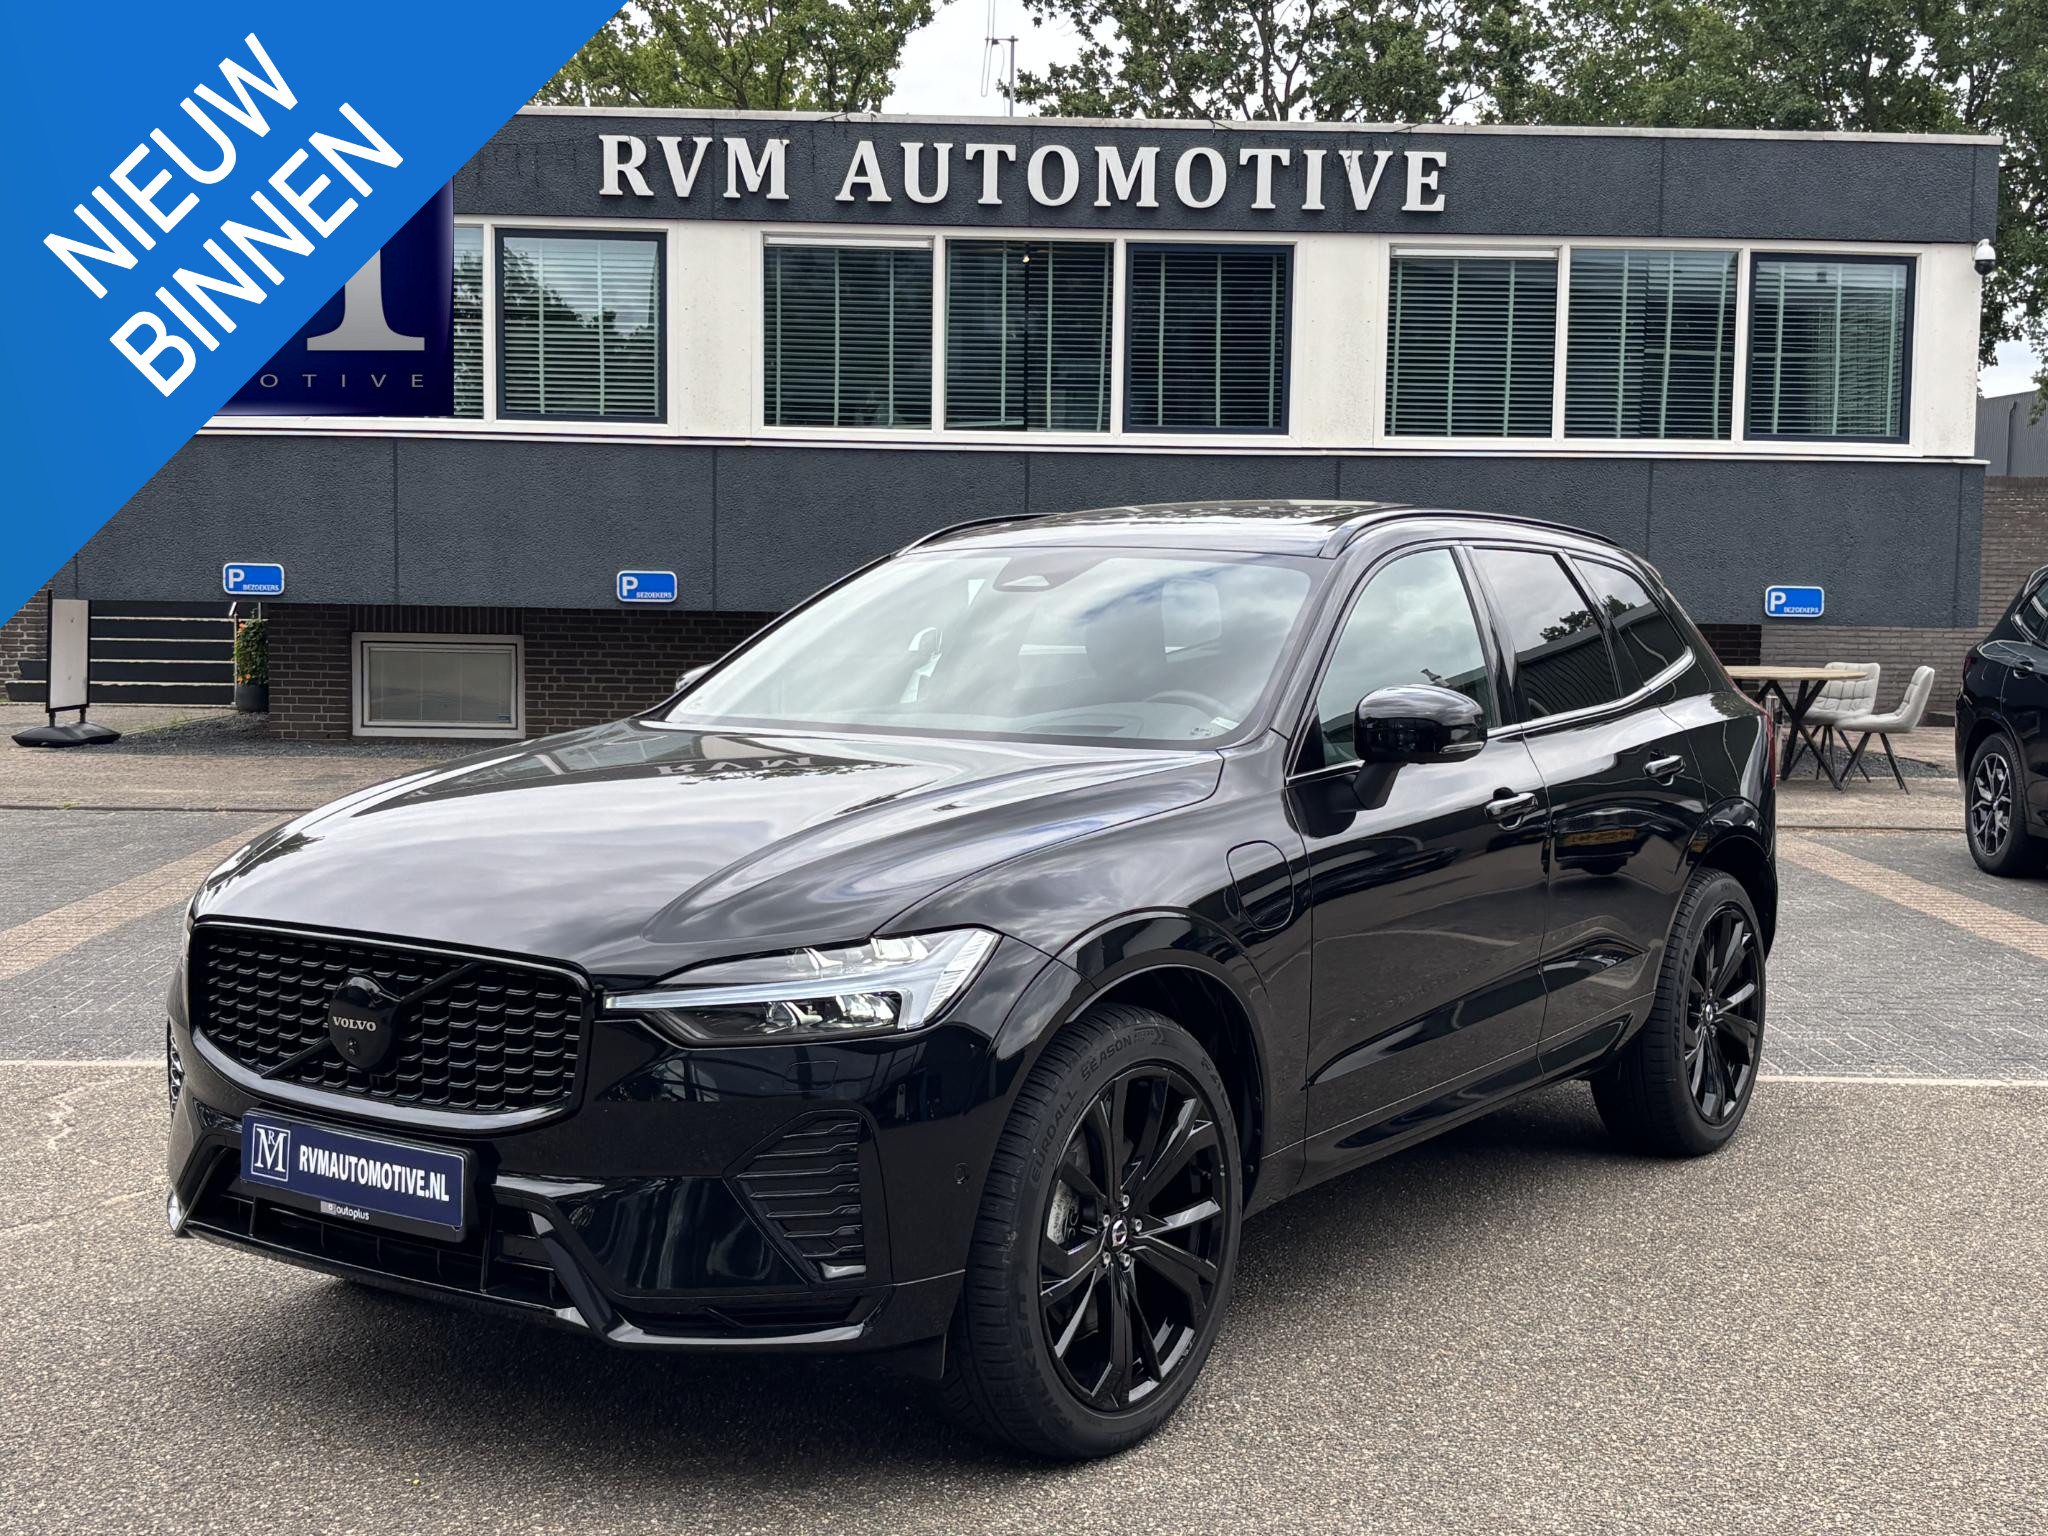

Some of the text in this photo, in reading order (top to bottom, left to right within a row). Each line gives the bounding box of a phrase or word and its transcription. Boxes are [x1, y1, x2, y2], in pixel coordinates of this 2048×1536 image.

[599, 134, 1448, 213] RVM AUTOMOTIVE
[228, 568, 245, 589] P
[242, 584, 280, 592] BEZOEKERS
[622, 576, 639, 597] P
[636, 591, 673, 599] BEZOEKERS
[1769, 591, 1787, 612] P
[332, 1015, 377, 1033] VOLVO
[1080, 1034, 1133, 1082] SEASON
[299, 1144, 450, 1202] RVMAUTOMOTIVE.NL
[336, 1204, 371, 1221] autoplus
